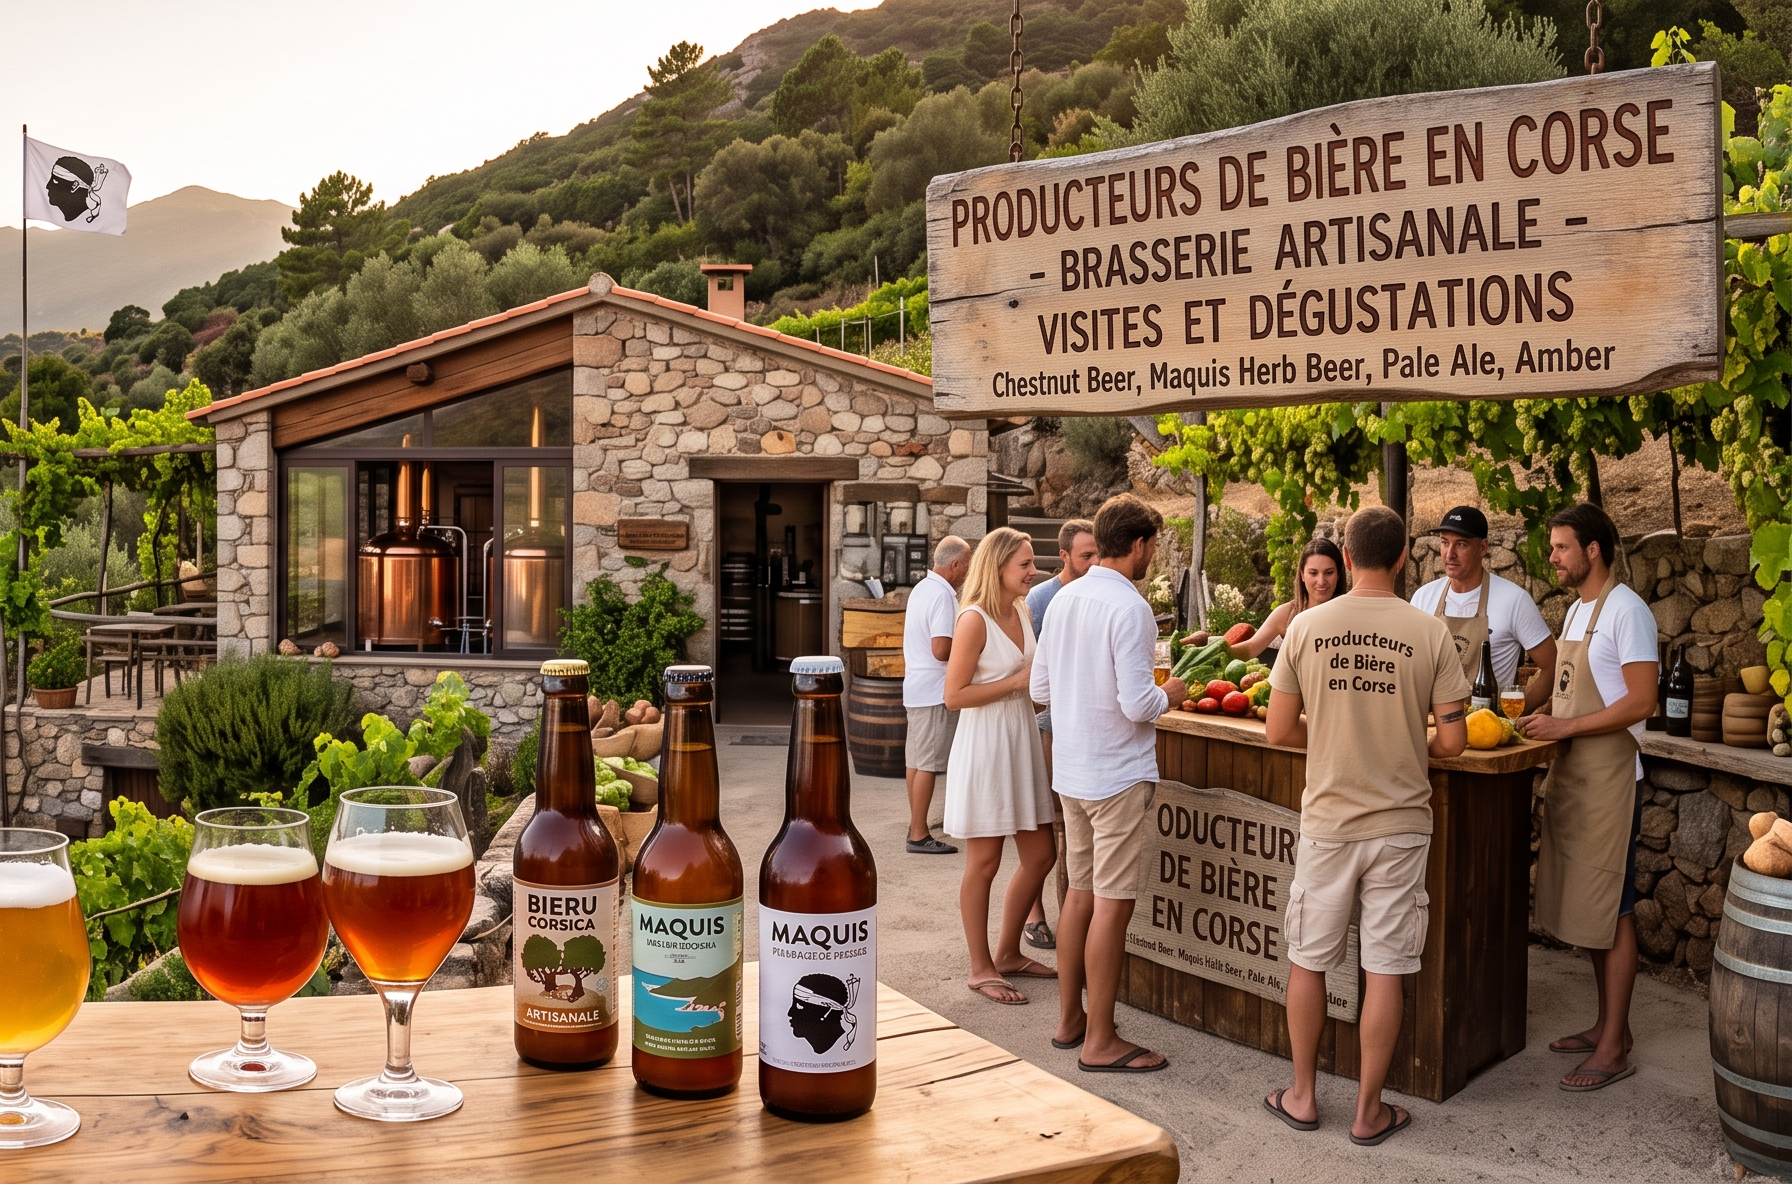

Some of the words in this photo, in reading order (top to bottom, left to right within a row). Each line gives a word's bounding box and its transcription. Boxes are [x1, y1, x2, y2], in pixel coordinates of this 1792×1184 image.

[952, 161, 1201, 247] PRODUCTEURS
[1219, 151, 1268, 211] DE
[1287, 122, 1406, 203] BIÈRE
[1427, 122, 1484, 186] EN
[1508, 99, 1674, 178] CORSE
[1061, 228, 1252, 292] BRASSERIE
[1275, 198, 1542, 270] ARTISANALE
[1037, 304, 1163, 355] VISITES
[1184, 298, 1226, 345] ET
[1249, 270, 1574, 341] DÉGUSTATIONS
[992, 369, 1080, 398] Chestnut
[1087, 366, 1142, 396] Beer,
[1150, 358, 1230, 396] Maquis
[1239, 354, 1297, 386] Herb
[1306, 353, 1372, 386] Beer,
[1383, 346, 1440, 379] Pale
[1450, 343, 1505, 381] Ale,
[1515, 338, 1616, 374] Amber
[1314, 630, 1414, 658] Producteurs
[1330, 653, 1349, 669] de
[1354, 654, 1396, 674] Bière
[1328, 678, 1348, 690] en
[1352, 675, 1396, 694] Corse
[1157, 802, 1300, 866] ODUCTEUR
[1160, 850, 1191, 890] DE
[1200, 857, 1278, 912] BIÈRE
[527, 893, 597, 916] BIERU
[527, 916, 596, 931] CORSICA
[639, 913, 725, 941] MAQUIS
[771, 920, 869, 951] MAQUIS
[1152, 894, 1183, 935] EN
[1192, 907, 1280, 962] CORSE
[526, 1007, 600, 1023] ARTISANALE
